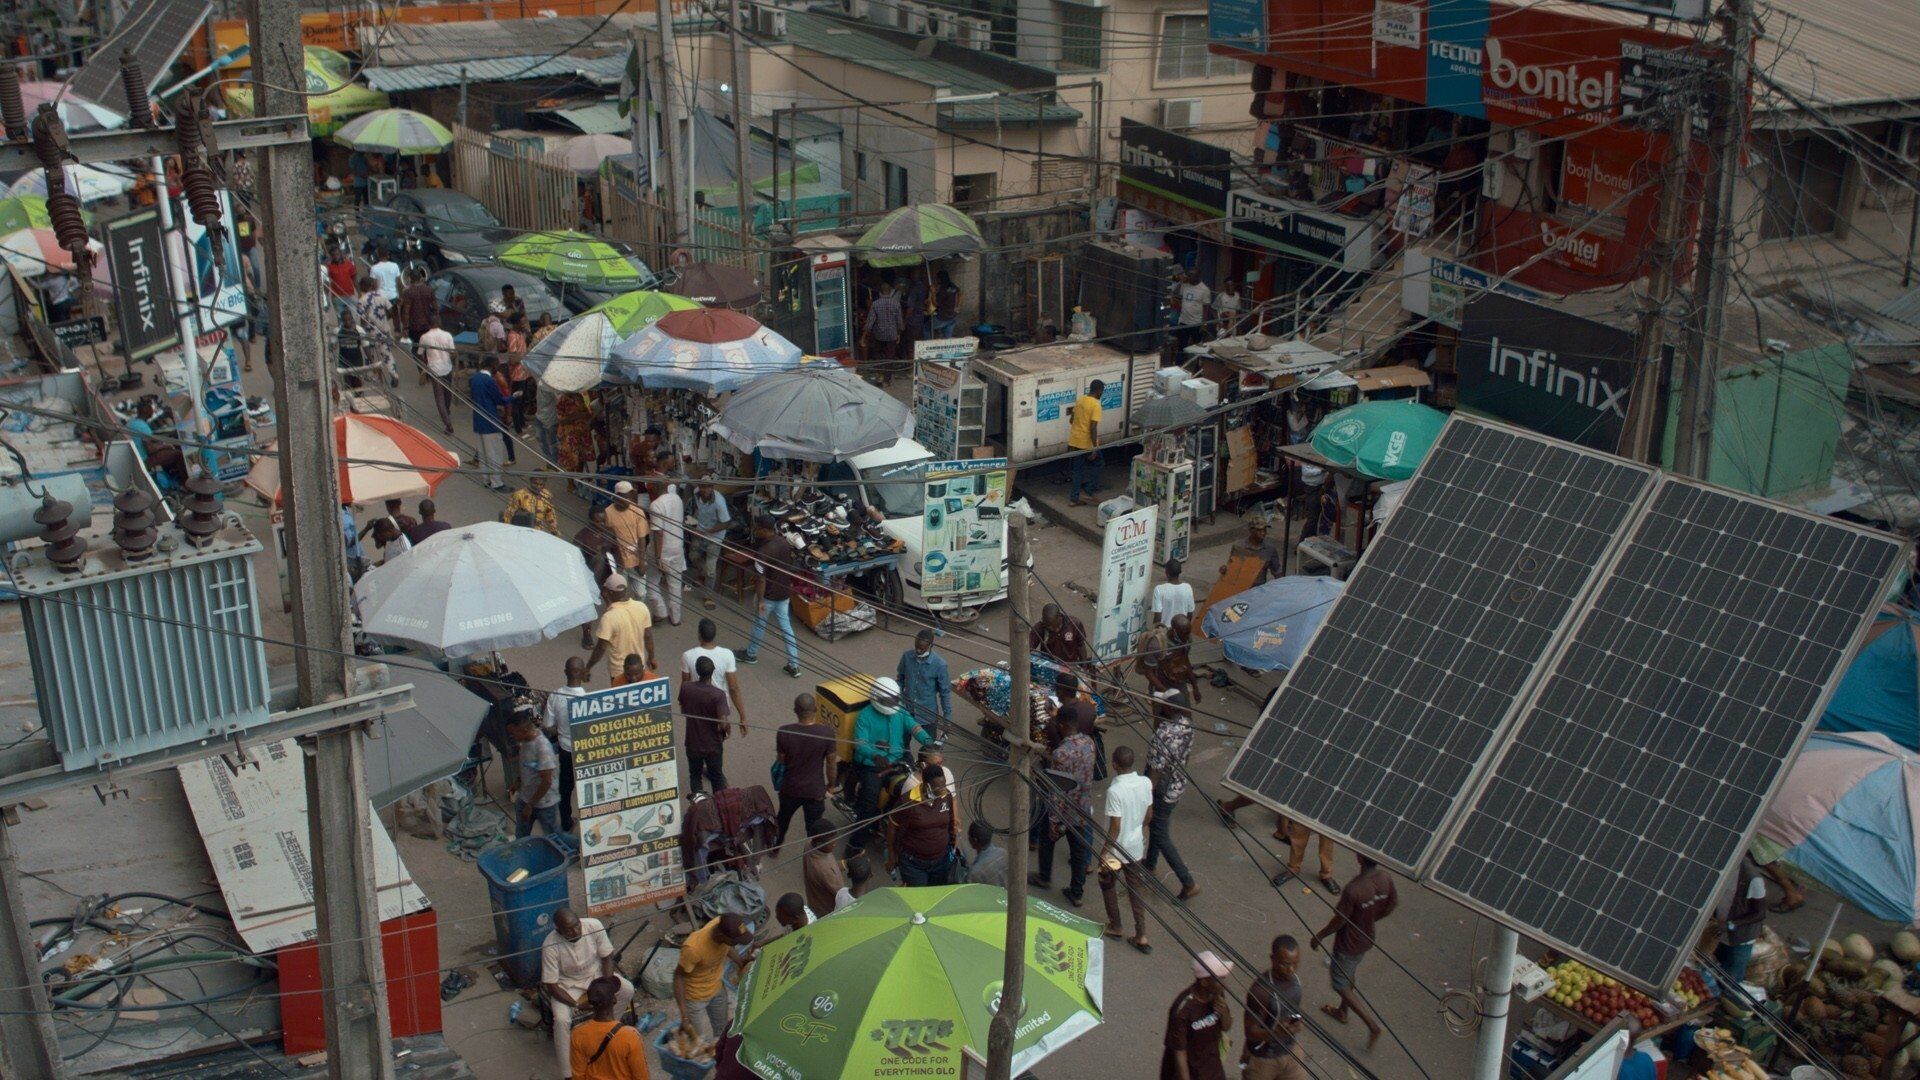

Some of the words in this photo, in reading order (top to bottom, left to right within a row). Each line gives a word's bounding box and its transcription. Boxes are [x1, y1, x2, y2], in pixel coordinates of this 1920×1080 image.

[1429, 40, 1482, 65] TECNO
[1485, 37, 1613, 108] bontel
[127, 237, 155, 332] Infinix
[227, 293, 244, 308] BIG
[1489, 337, 1628, 418] Infinix
[385, 614, 431, 630] SAMSUNG
[459, 612, 514, 631] SAMSUNG
[572, 684, 667, 719] MABTECH
[589, 713, 652, 735] ORIGINAL
[820, 704, 840, 728] EKO
[574, 734, 608, 752] PHONE
[609, 721, 672, 744] ACCESSORIES
[576, 753, 585, 763] &
[587, 744, 630, 761] PHONE
[632, 735, 670, 751] PARTS
[633, 750, 671, 767] FLEX
[576, 760, 625, 780] BATTERY
[641, 844, 650, 854] &
[652, 838, 679, 850] Tools
[813, 995, 834, 1012] glo
[753, 1060, 775, 1078] DATA
[766, 1052, 788, 1071] VOICE
[784, 1065, 802, 1080] AND
[881, 1057, 900, 1065] ONE
[902, 1056, 928, 1065] CODE
[930, 1056, 949, 1064] FOR
[874, 1067, 934, 1076] EVERYTHING
[936, 1067, 955, 1075] GLO
